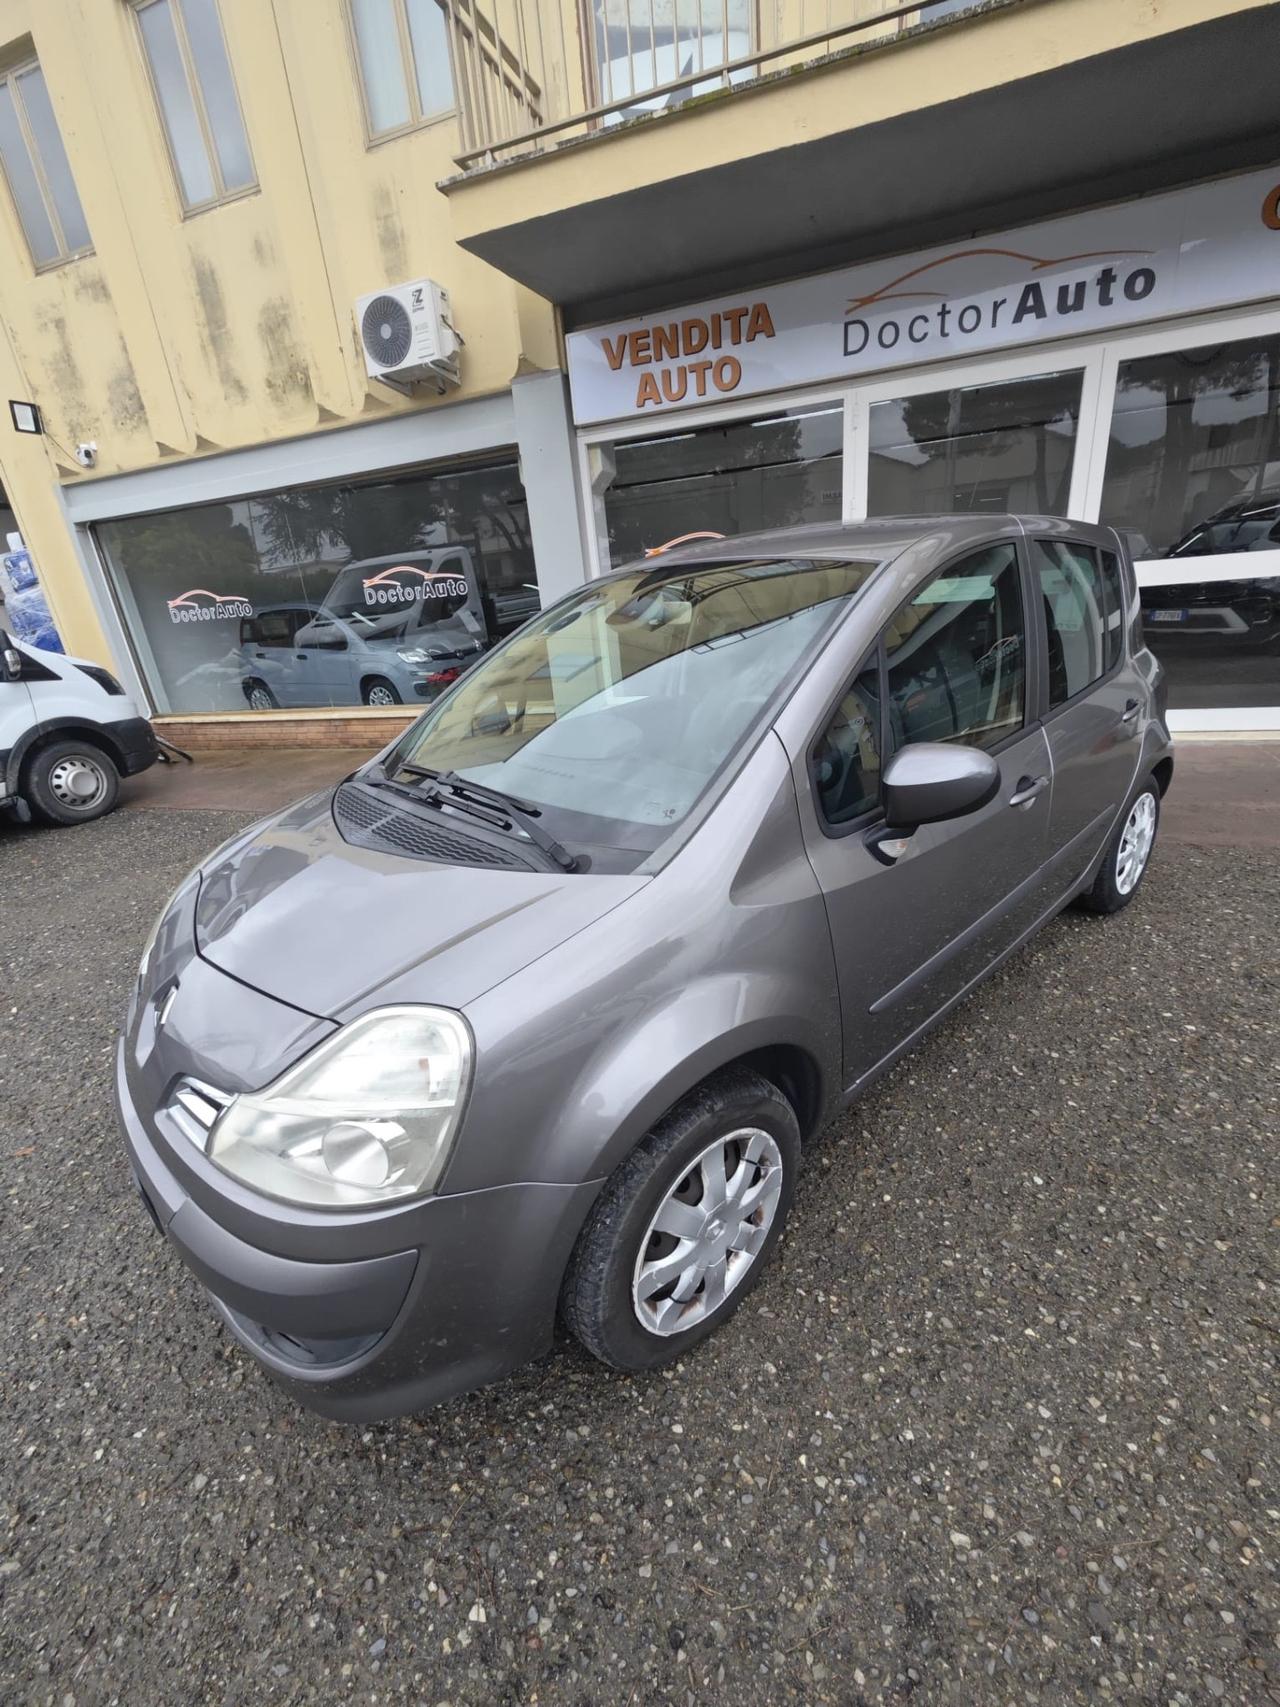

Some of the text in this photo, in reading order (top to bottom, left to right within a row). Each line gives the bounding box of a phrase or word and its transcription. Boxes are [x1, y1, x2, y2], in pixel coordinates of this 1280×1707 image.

[601, 302, 776, 370] VENDITA
[843, 267, 1156, 357] DoctorAuto
[635, 355, 742, 408] AUTO
[169, 602, 253, 623] DoctorAuto
[364, 579, 468, 605] DoctorAuto
